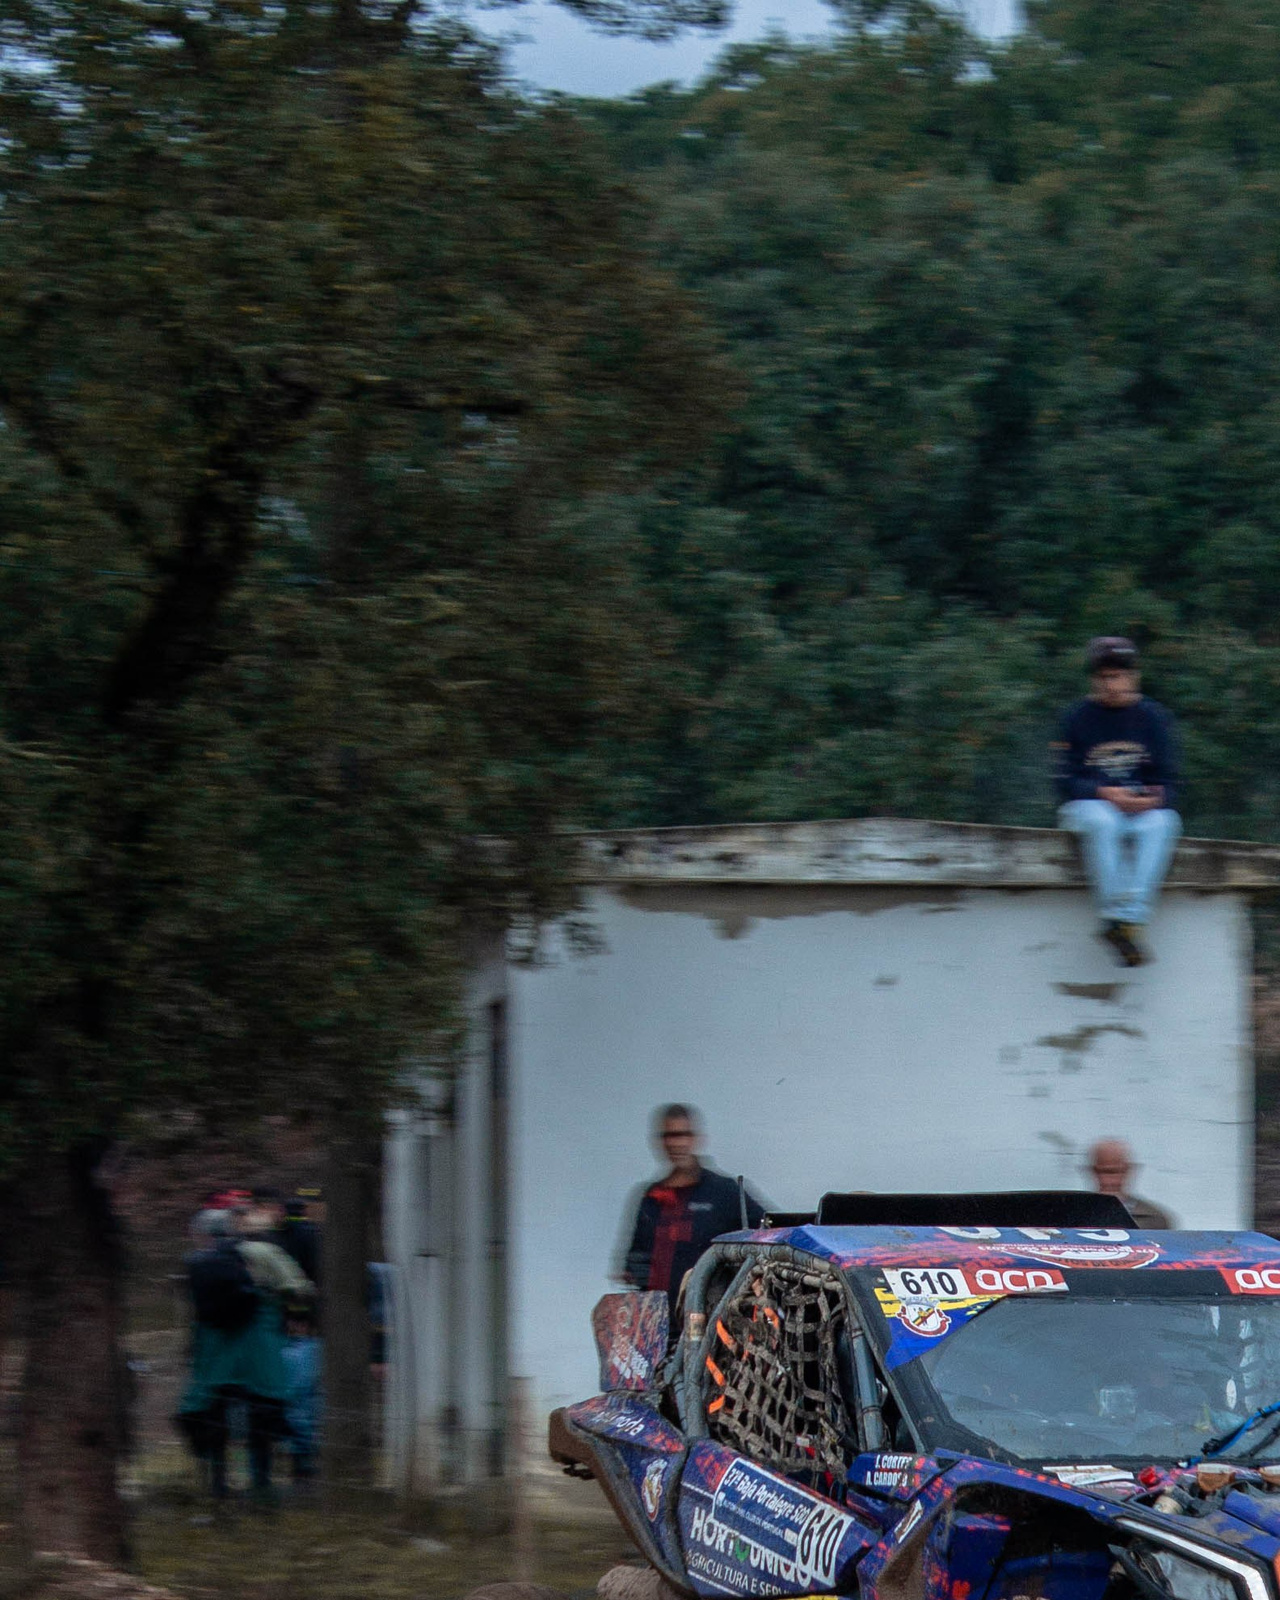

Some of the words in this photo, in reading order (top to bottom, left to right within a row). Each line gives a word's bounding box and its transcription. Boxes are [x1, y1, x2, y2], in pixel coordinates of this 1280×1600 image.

[900, 1271, 958, 1295] 610
[975, 1269, 1054, 1291] acp
[736, 1475, 758, 1500] Baja
[752, 1483, 795, 1519] Portalegre
[789, 1503, 811, 1526] 500
[800, 1508, 845, 1578] 610
[684, 1549, 748, 1590] AGRICULTURA
[751, 1578, 758, 1594] E
